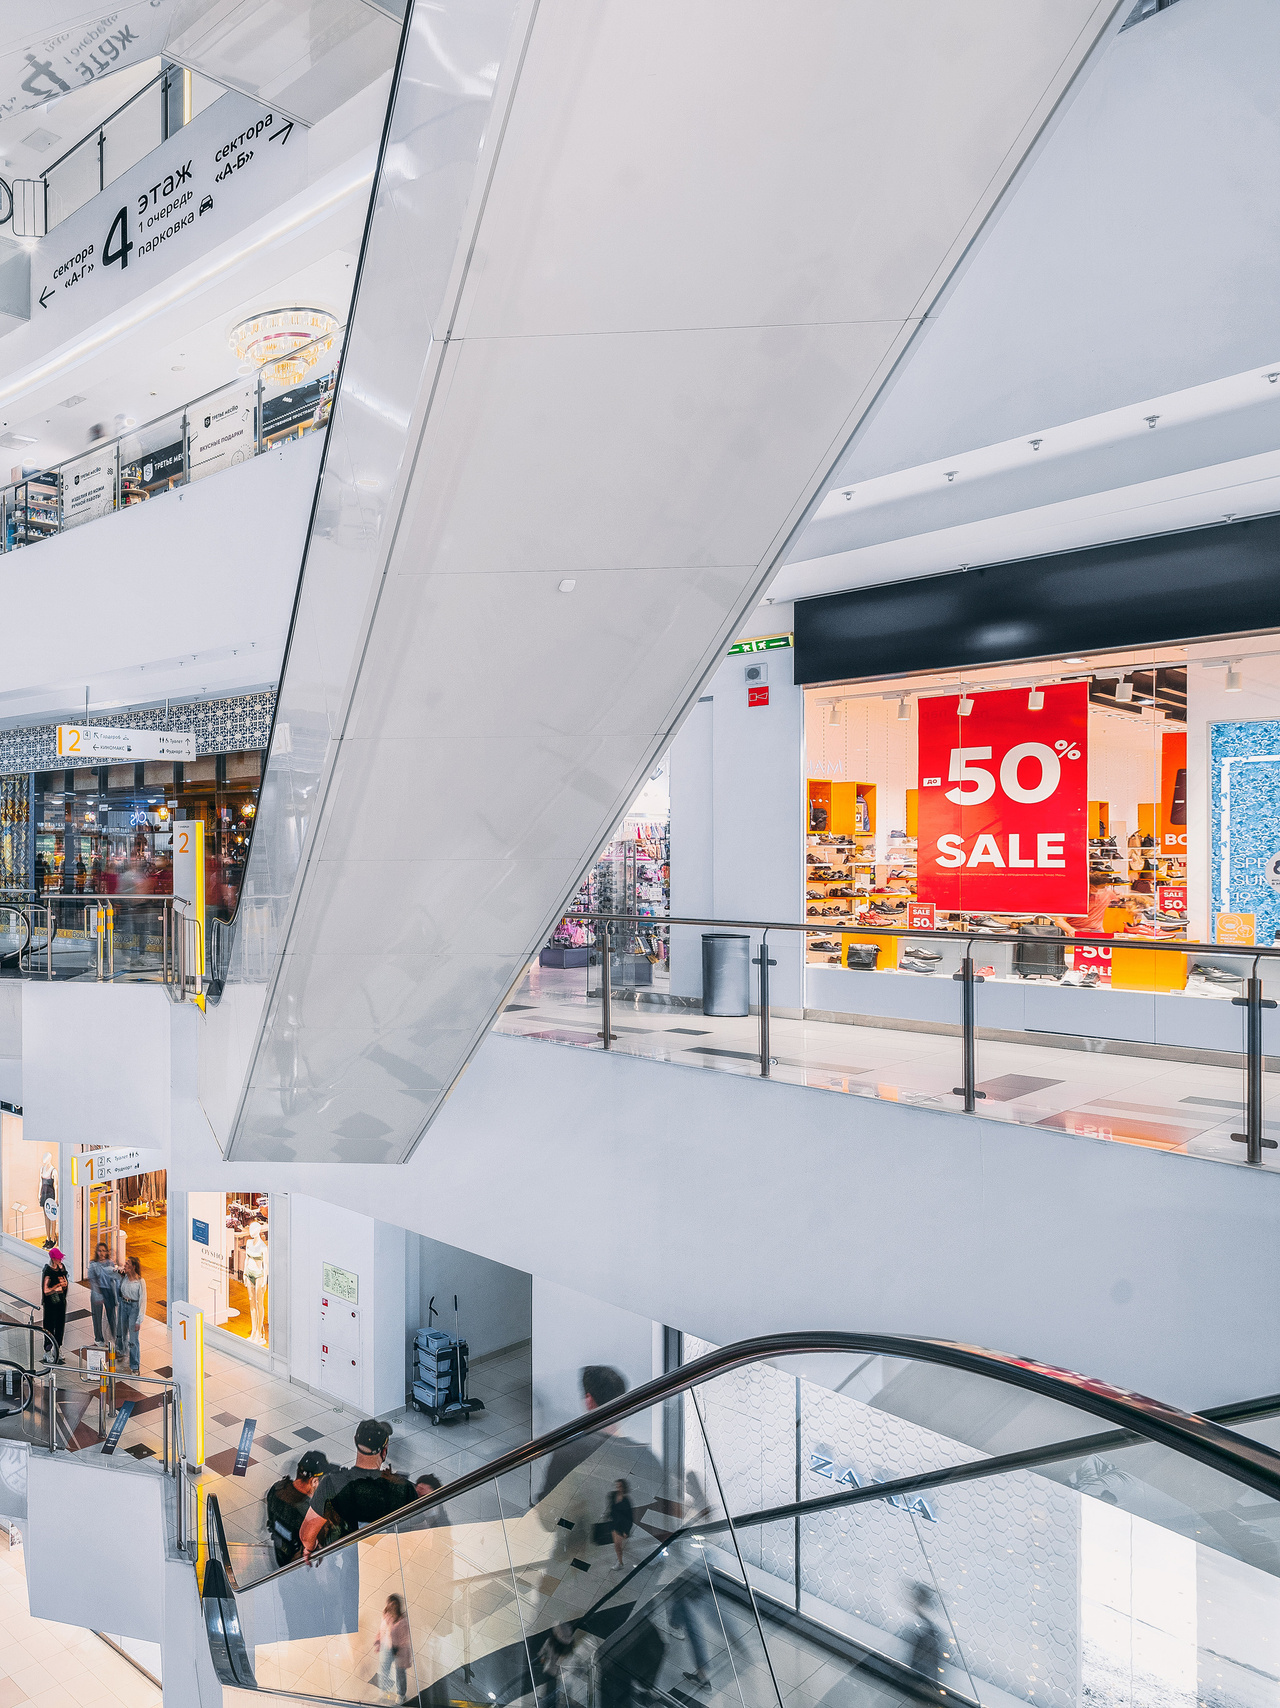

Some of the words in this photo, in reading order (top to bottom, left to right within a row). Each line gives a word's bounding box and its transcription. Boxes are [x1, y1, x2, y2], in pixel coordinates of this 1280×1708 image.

[215, 114, 273, 163] сектора
[215, 150, 254, 183] «А-Б»
[137, 160, 193, 215] этаж
[138, 221, 144, 233] 1
[146, 189, 193, 229] очередь
[102, 206, 134, 270] 4
[138, 211, 195, 257] парковка
[53, 244, 94, 279] сектора
[64, 263, 95, 288] «А-Г»
[200, 439, 220, 452] ВКУСНЫЕ
[221, 430, 244, 443] ПОДАРКИ
[154, 457, 172, 470] ТРЕТЬЕ
[68, 729, 81, 752] 2
[944, 739, 1082, 806] 50%
[178, 832, 189, 854] 2
[935, 832, 1066, 868] SALE
[84, 1158, 94, 1180] 1
[202, 1248, 224, 1260] OYSHO
[178, 1319, 186, 1341] 1
[809, 1452, 938, 1523] ZAA
